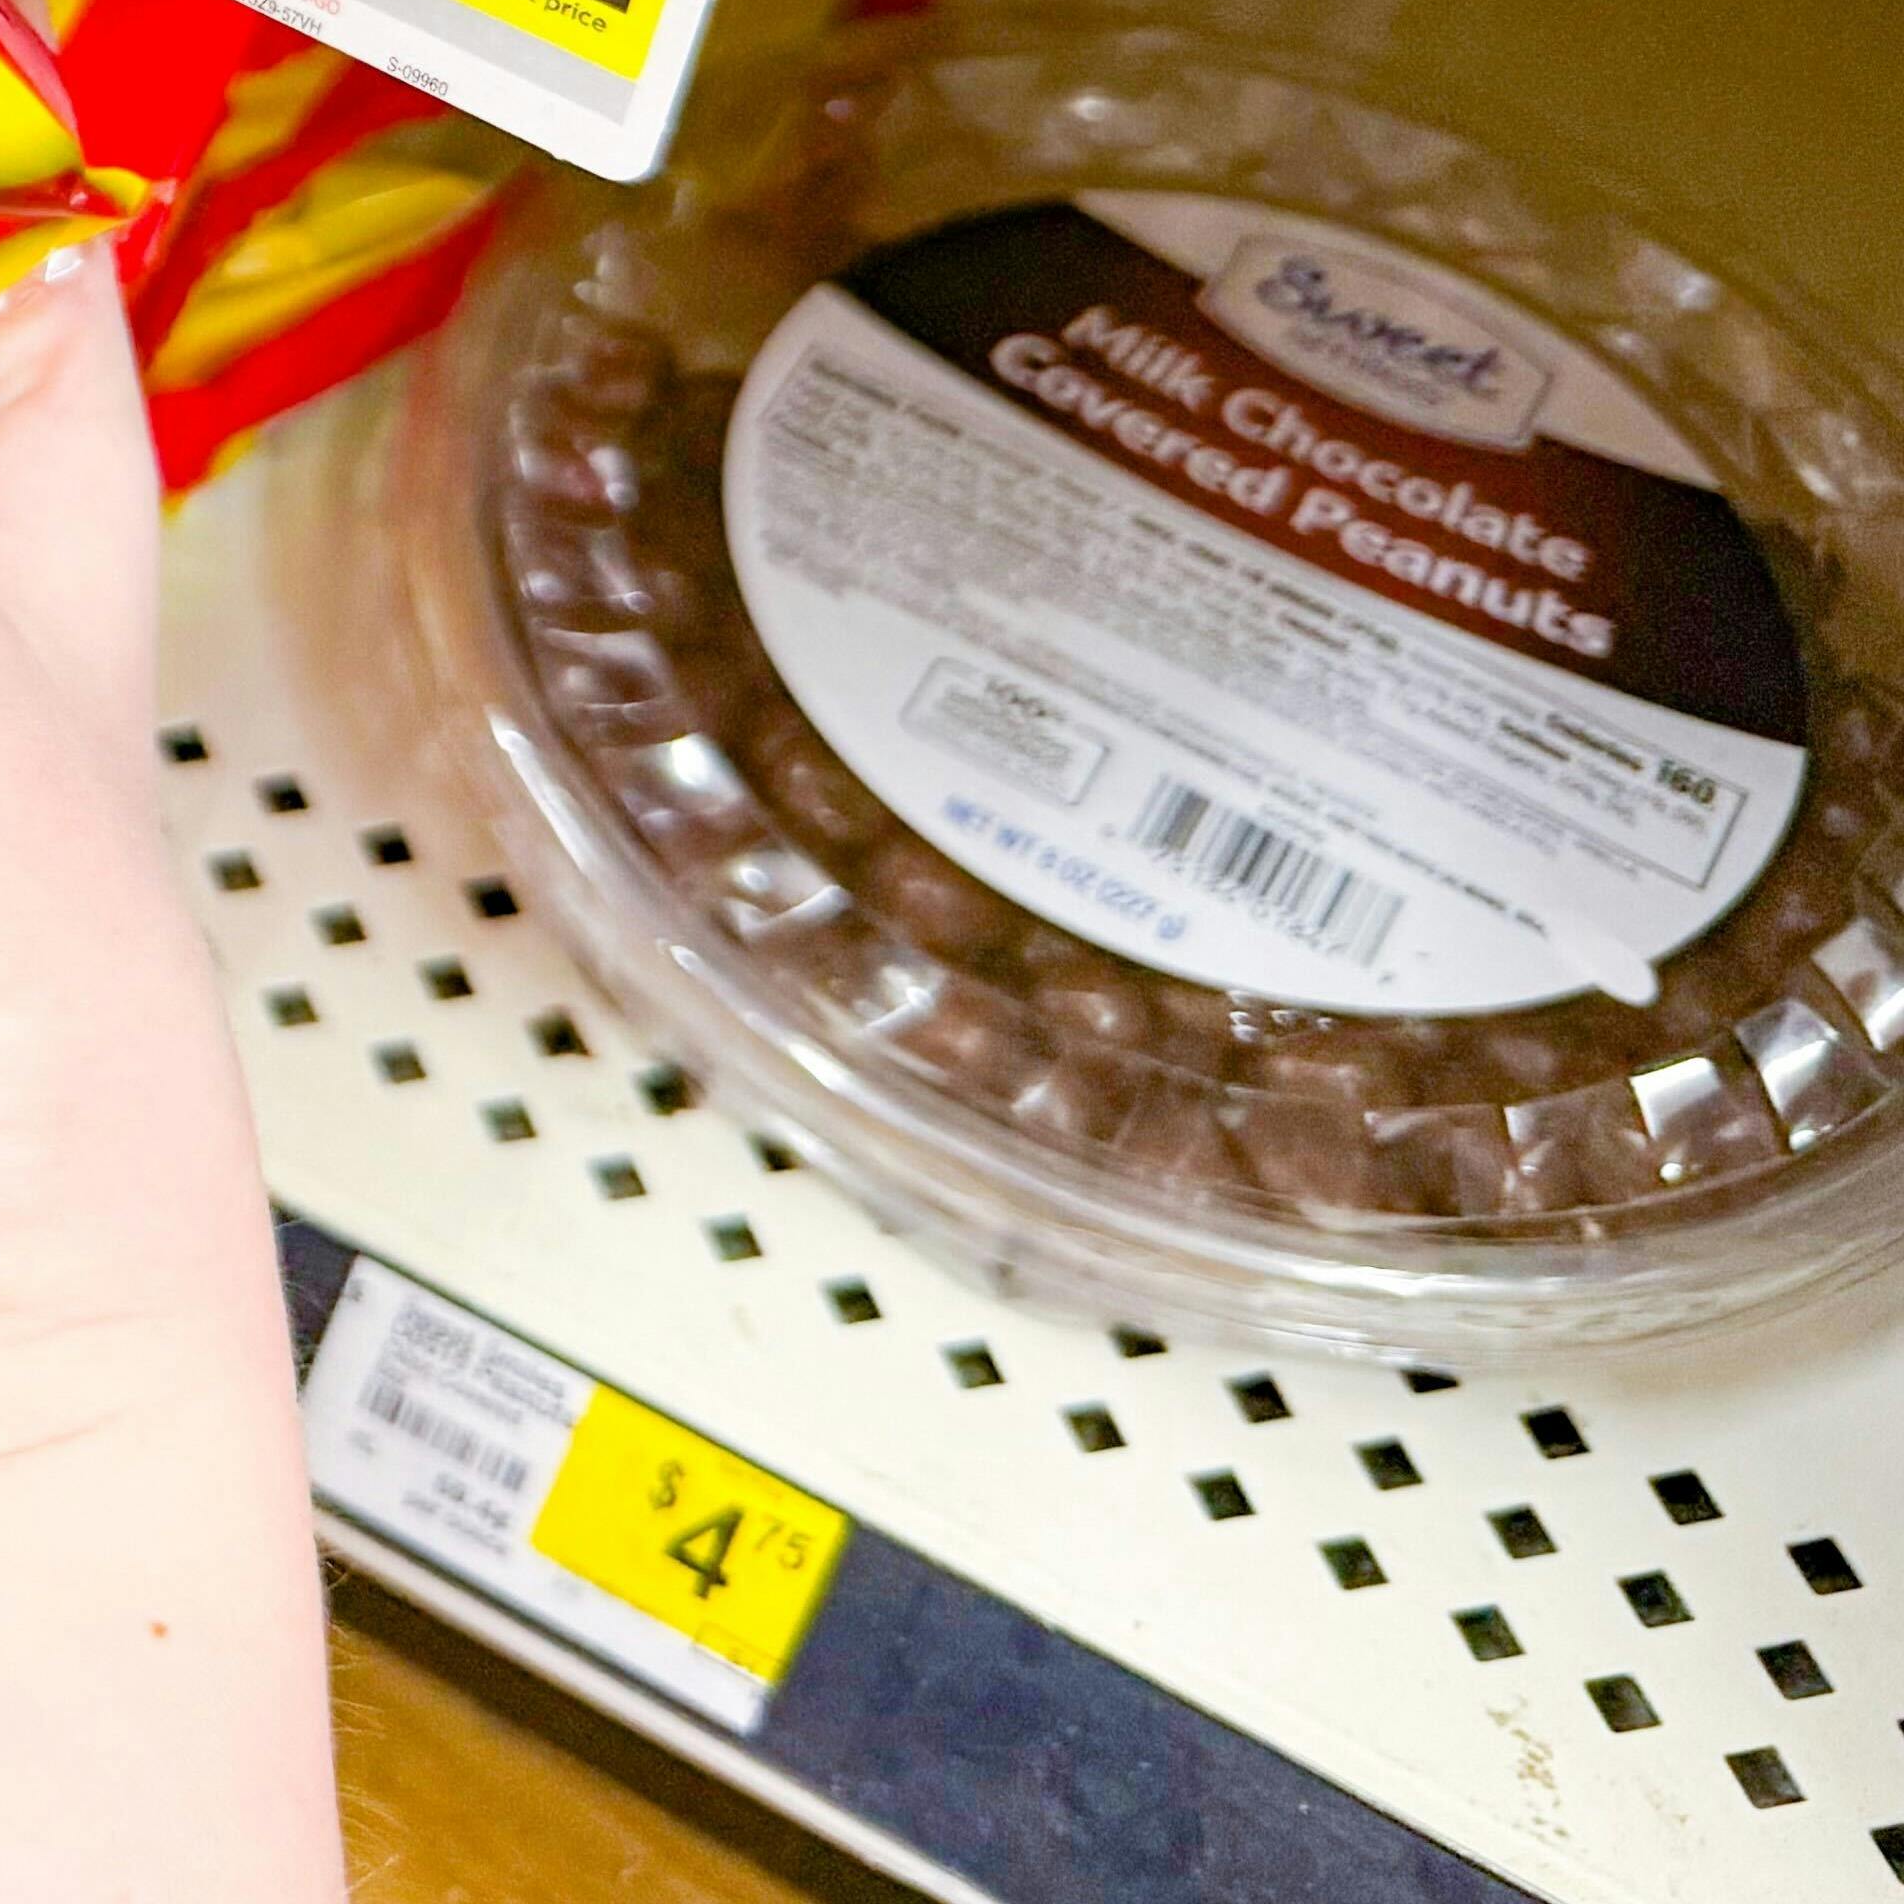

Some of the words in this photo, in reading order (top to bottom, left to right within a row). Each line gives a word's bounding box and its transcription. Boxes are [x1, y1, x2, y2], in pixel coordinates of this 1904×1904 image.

[387, 56, 449, 97] S-09960
[1255, 251, 1502, 397] Sweet
[992, 332, 1290, 515] Covered
[1291, 489, 1614, 659] Peanuts
[1060, 305, 1215, 410] Milk
[1223, 386, 1589, 583] Chocolate
